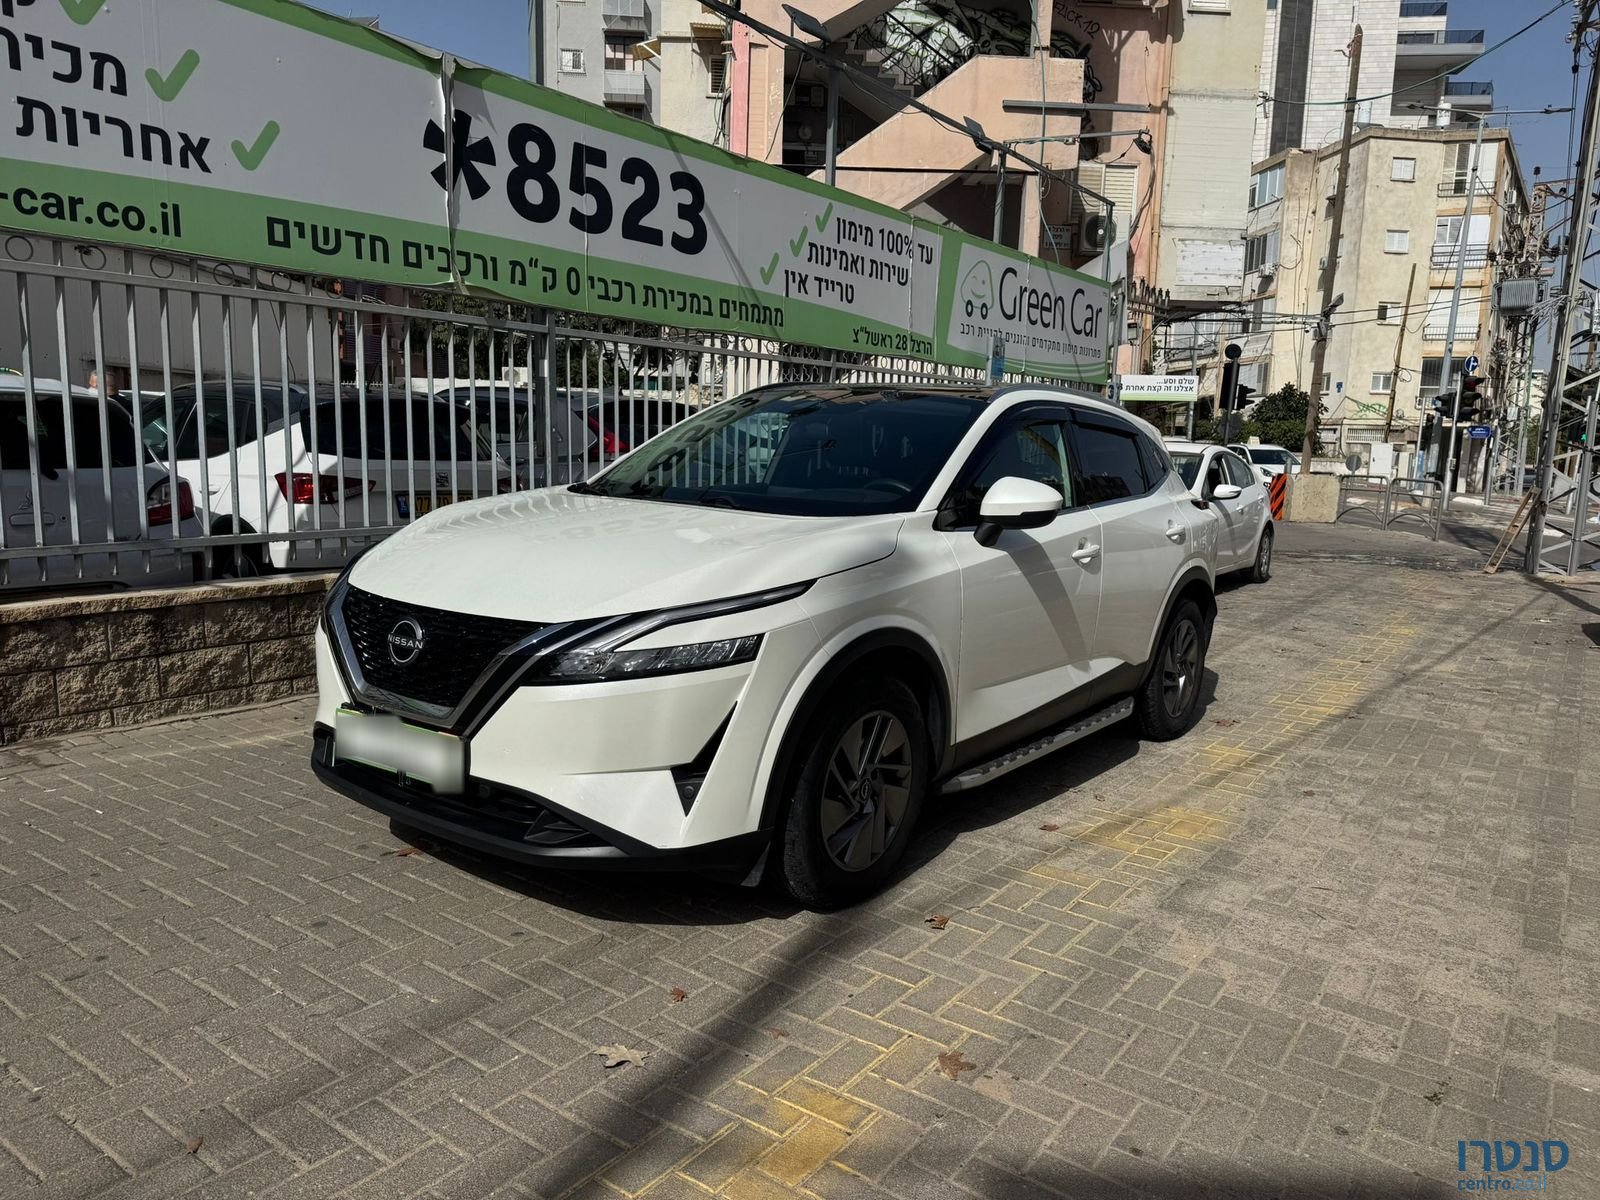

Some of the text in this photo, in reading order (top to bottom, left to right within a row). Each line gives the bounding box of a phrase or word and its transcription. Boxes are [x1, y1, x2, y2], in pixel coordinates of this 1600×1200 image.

[16, 96, 212, 173] אחריות
[266, 216, 390, 264] חדשים
[836, 217, 933, 265] עד 100% מימון
[402, 240, 499, 282] ורכבים
[807, 241, 909, 286] שירות ואמינות
[588, 275, 636, 305] רכבי
[643, 284, 713, 316] במכירת
[784, 269, 855, 304] טרייד אין
[719, 298, 784, 327] מתמחים
[999, 267, 1102, 338] Green Car
[895, 333, 908, 351] 28
[960, 323, 975, 336] רכב
[1005, 332, 1030, 346] והוגנים
[910, 335, 933, 356] הרצל
[1147, 385, 1162, 393] קצת
[1178, 377, 1194, 385] שלם
[388, 634, 424, 649] NISSAN
